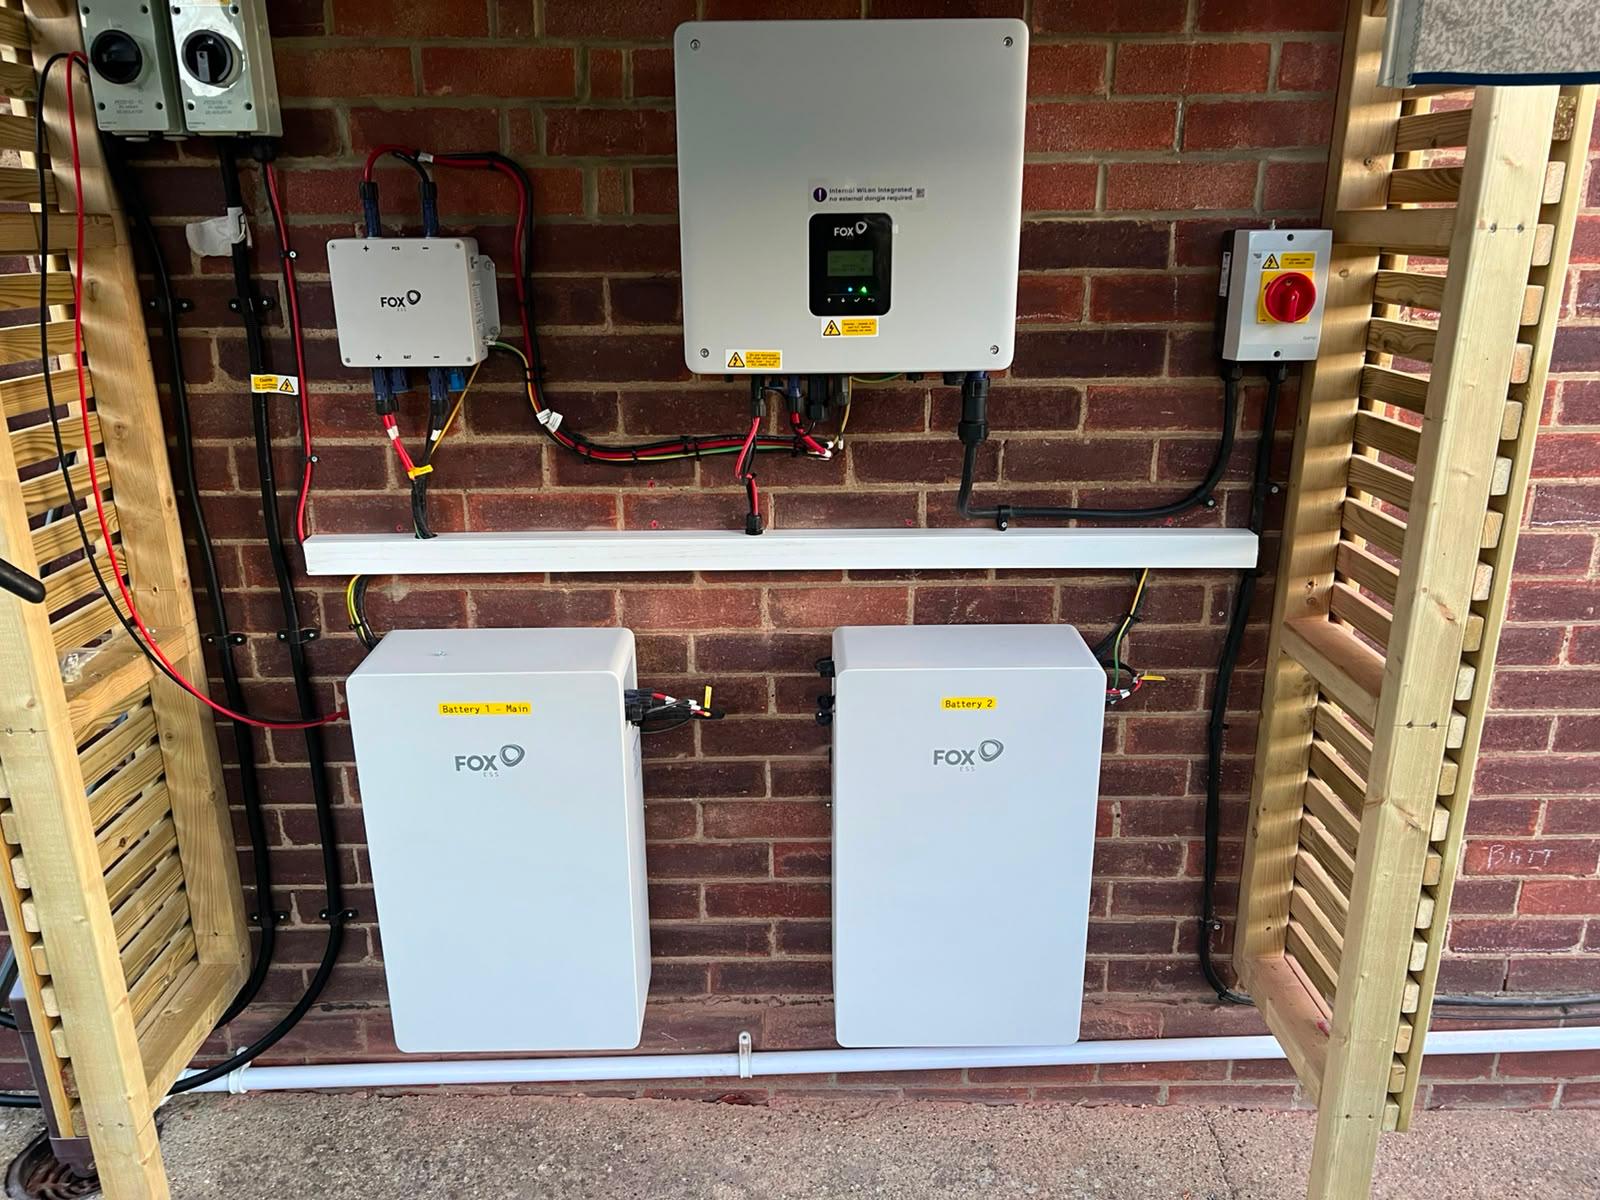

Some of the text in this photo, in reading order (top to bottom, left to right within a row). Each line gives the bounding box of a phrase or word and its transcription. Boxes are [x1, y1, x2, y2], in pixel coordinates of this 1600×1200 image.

[833, 227, 854, 237] FOX
[380, 296, 406, 308] FOX
[442, 705, 480, 714] Battery
[505, 703, 529, 713] Main
[945, 698, 993, 709] Battery 2
[455, 755, 498, 771] FOX
[934, 750, 975, 766] FOX
